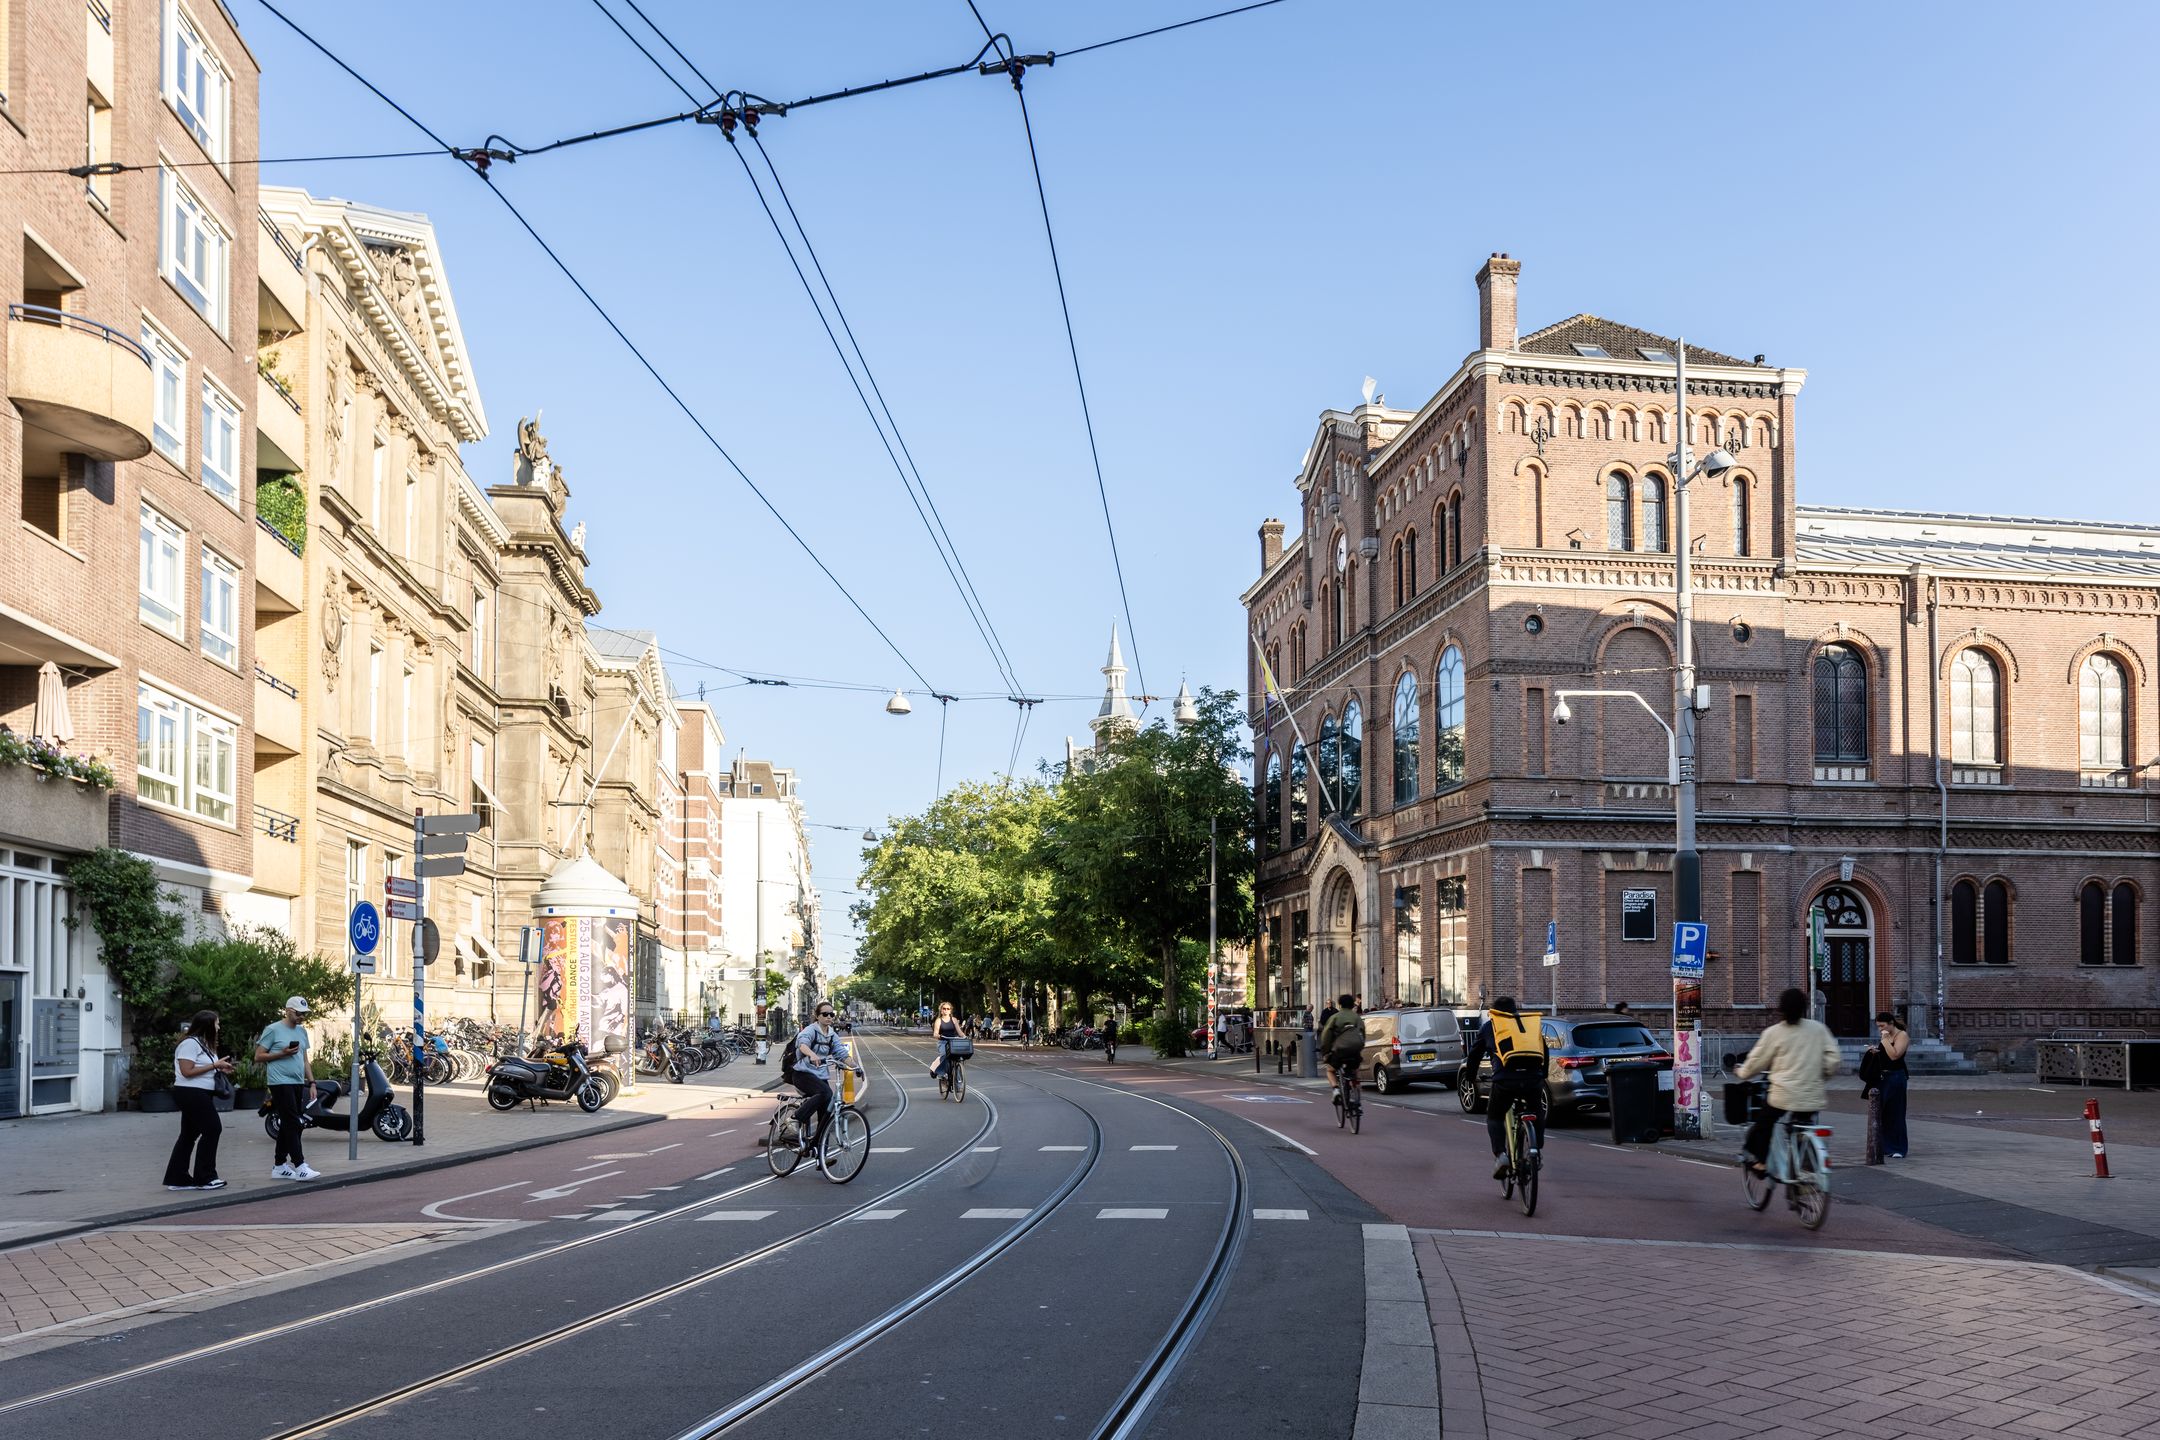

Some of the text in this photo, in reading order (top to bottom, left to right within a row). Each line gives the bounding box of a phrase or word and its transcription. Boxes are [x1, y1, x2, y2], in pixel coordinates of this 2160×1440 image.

[1624, 891, 1654, 899] Paradiso
[569, 919, 577, 955] FESTIVAL
[580, 919, 590, 948] 25-31
[1681, 926, 1700, 949] P
[569, 959, 577, 987] DANCE
[580, 952, 590, 973] AUG
[580, 976, 590, 1002] 2026
